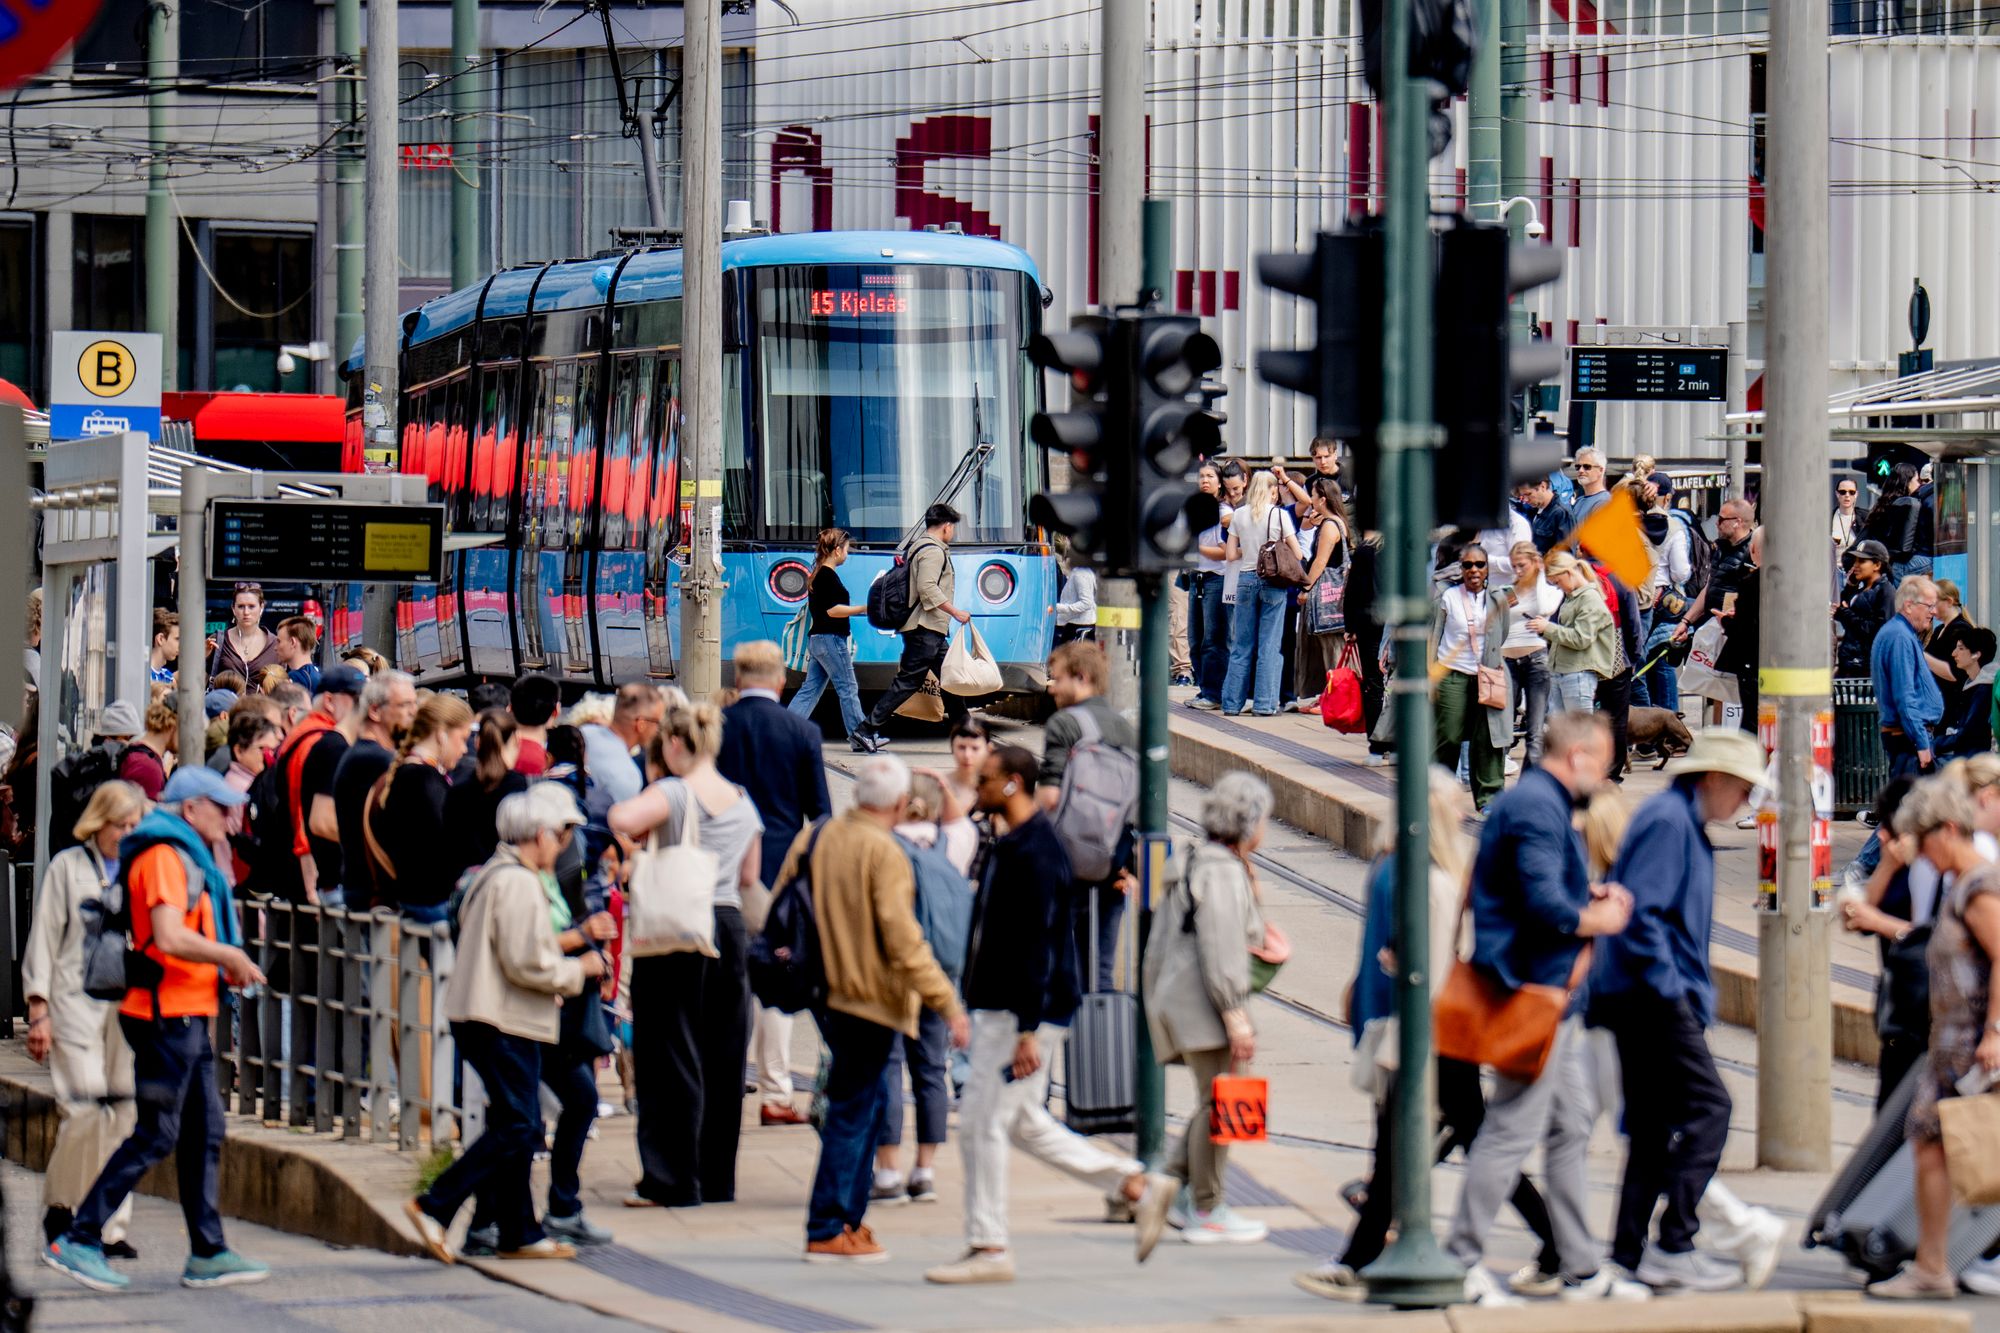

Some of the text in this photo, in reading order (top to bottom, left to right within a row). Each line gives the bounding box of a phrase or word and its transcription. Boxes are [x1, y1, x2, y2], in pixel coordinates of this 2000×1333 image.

[812, 292, 907, 317] 15 Kjelsås
[96, 351, 122, 386] B
[1678, 380, 1709, 390] 2 min
